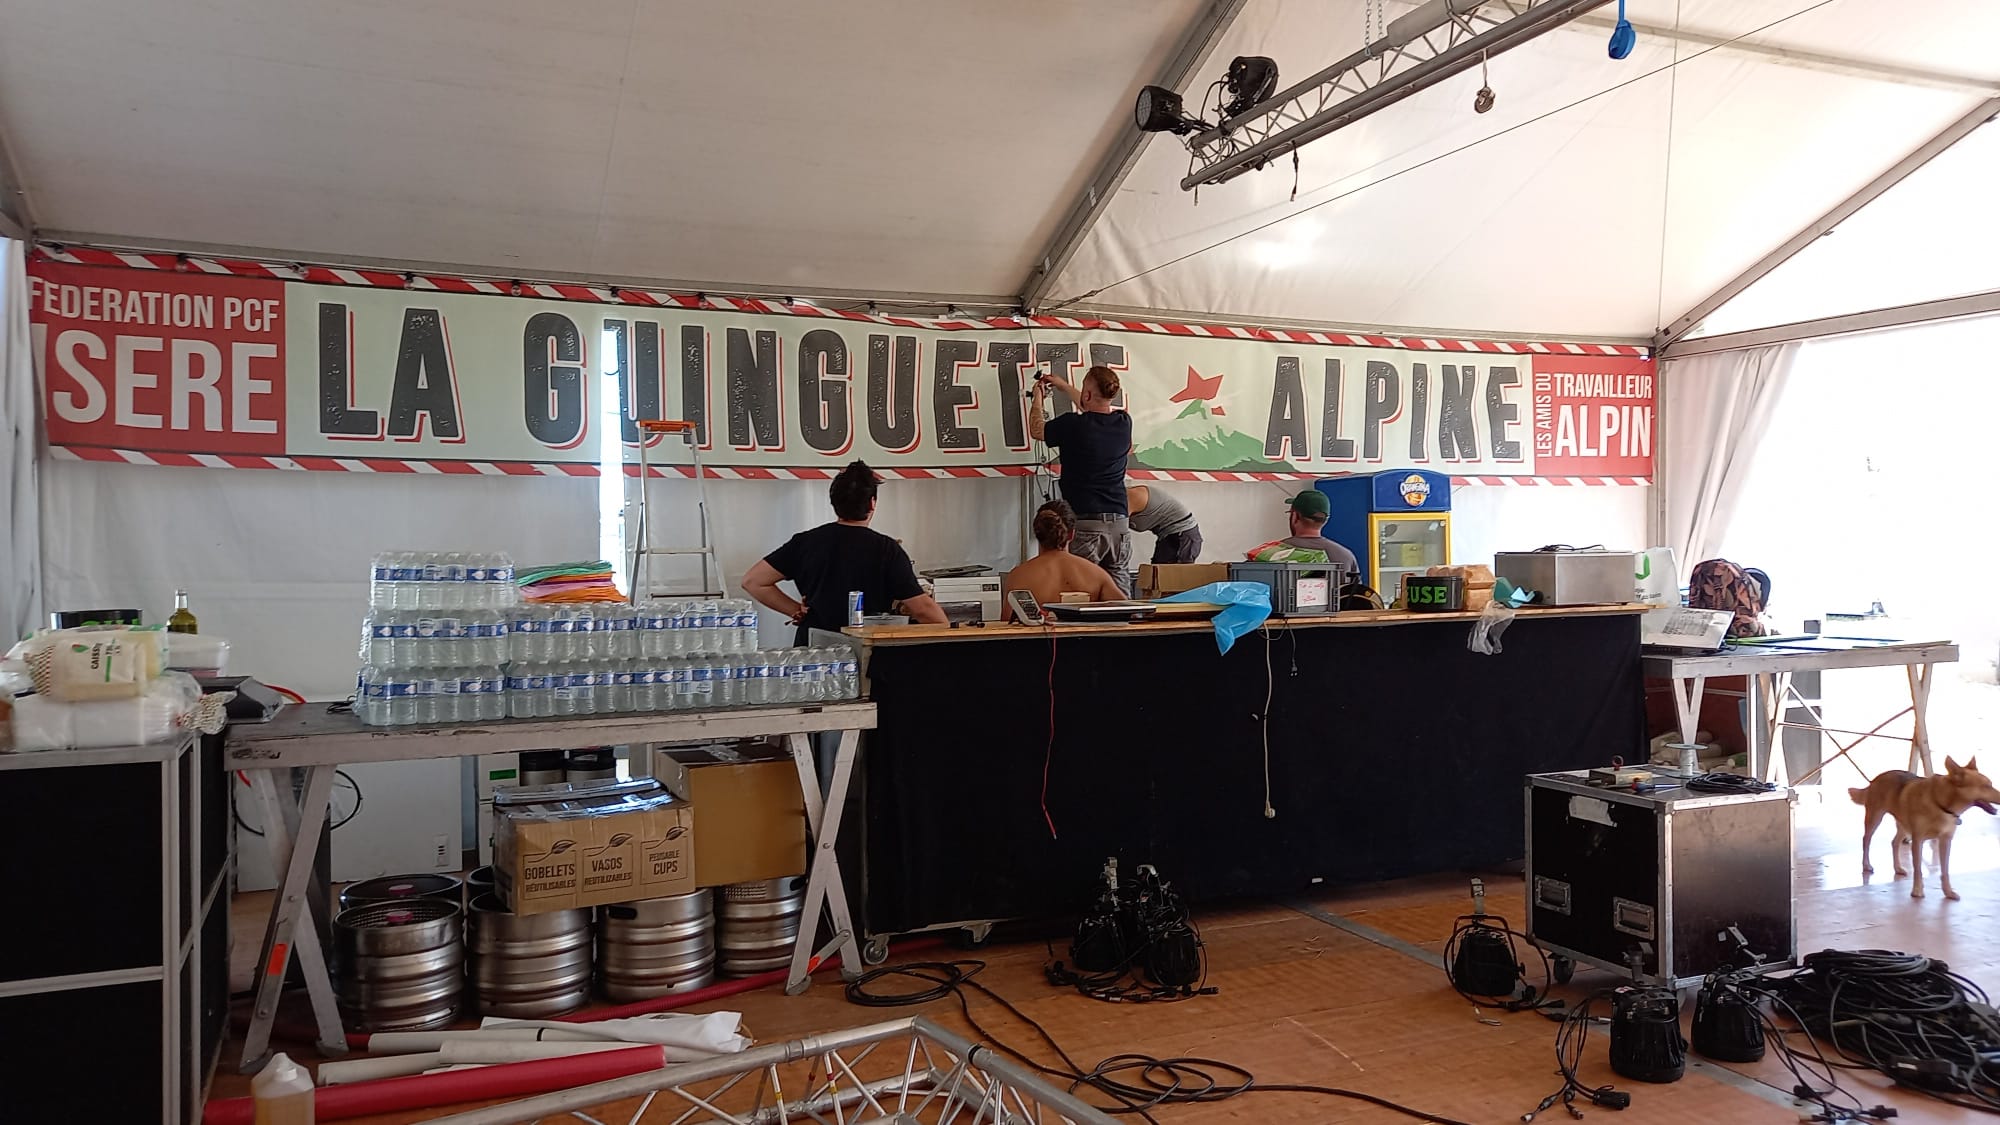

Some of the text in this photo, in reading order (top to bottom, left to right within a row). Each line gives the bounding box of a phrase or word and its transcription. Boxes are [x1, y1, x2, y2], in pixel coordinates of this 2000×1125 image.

[27, 276, 280, 332] FEDERATION PCF
[319, 302, 465, 444] LA
[1264, 356, 1525, 463] ALPINE
[1554, 373, 1652, 399] TRAVAILLEUR
[1535, 373, 1552, 457] LES AMIS DU
[1554, 404, 1651, 457] ALPIN
[1407, 586, 1448, 603] USE
[524, 863, 575, 880] GOBELETS
[592, 857, 623, 872] VASOS
[653, 861, 678, 876] CUPS
